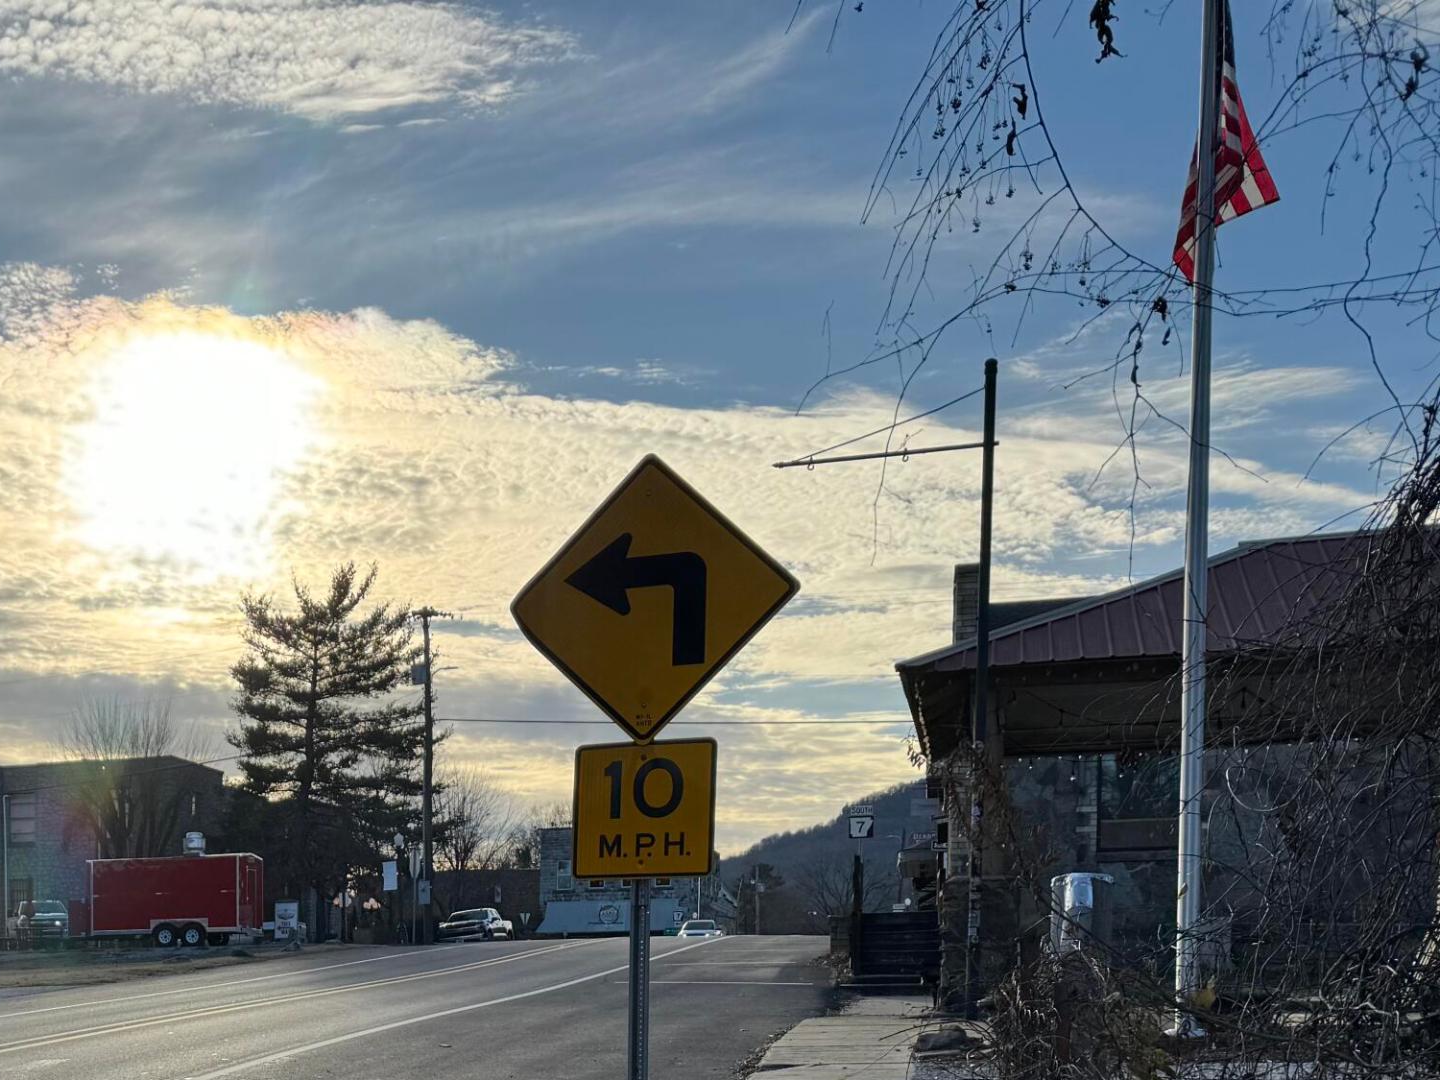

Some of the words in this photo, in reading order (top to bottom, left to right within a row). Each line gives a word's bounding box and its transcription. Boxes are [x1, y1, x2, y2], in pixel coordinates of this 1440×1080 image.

[604, 758, 684, 819] 10
[851, 806, 873, 814] SOUTH
[856, 821, 865, 834] 7
[599, 832, 691, 858] M.P.H.
